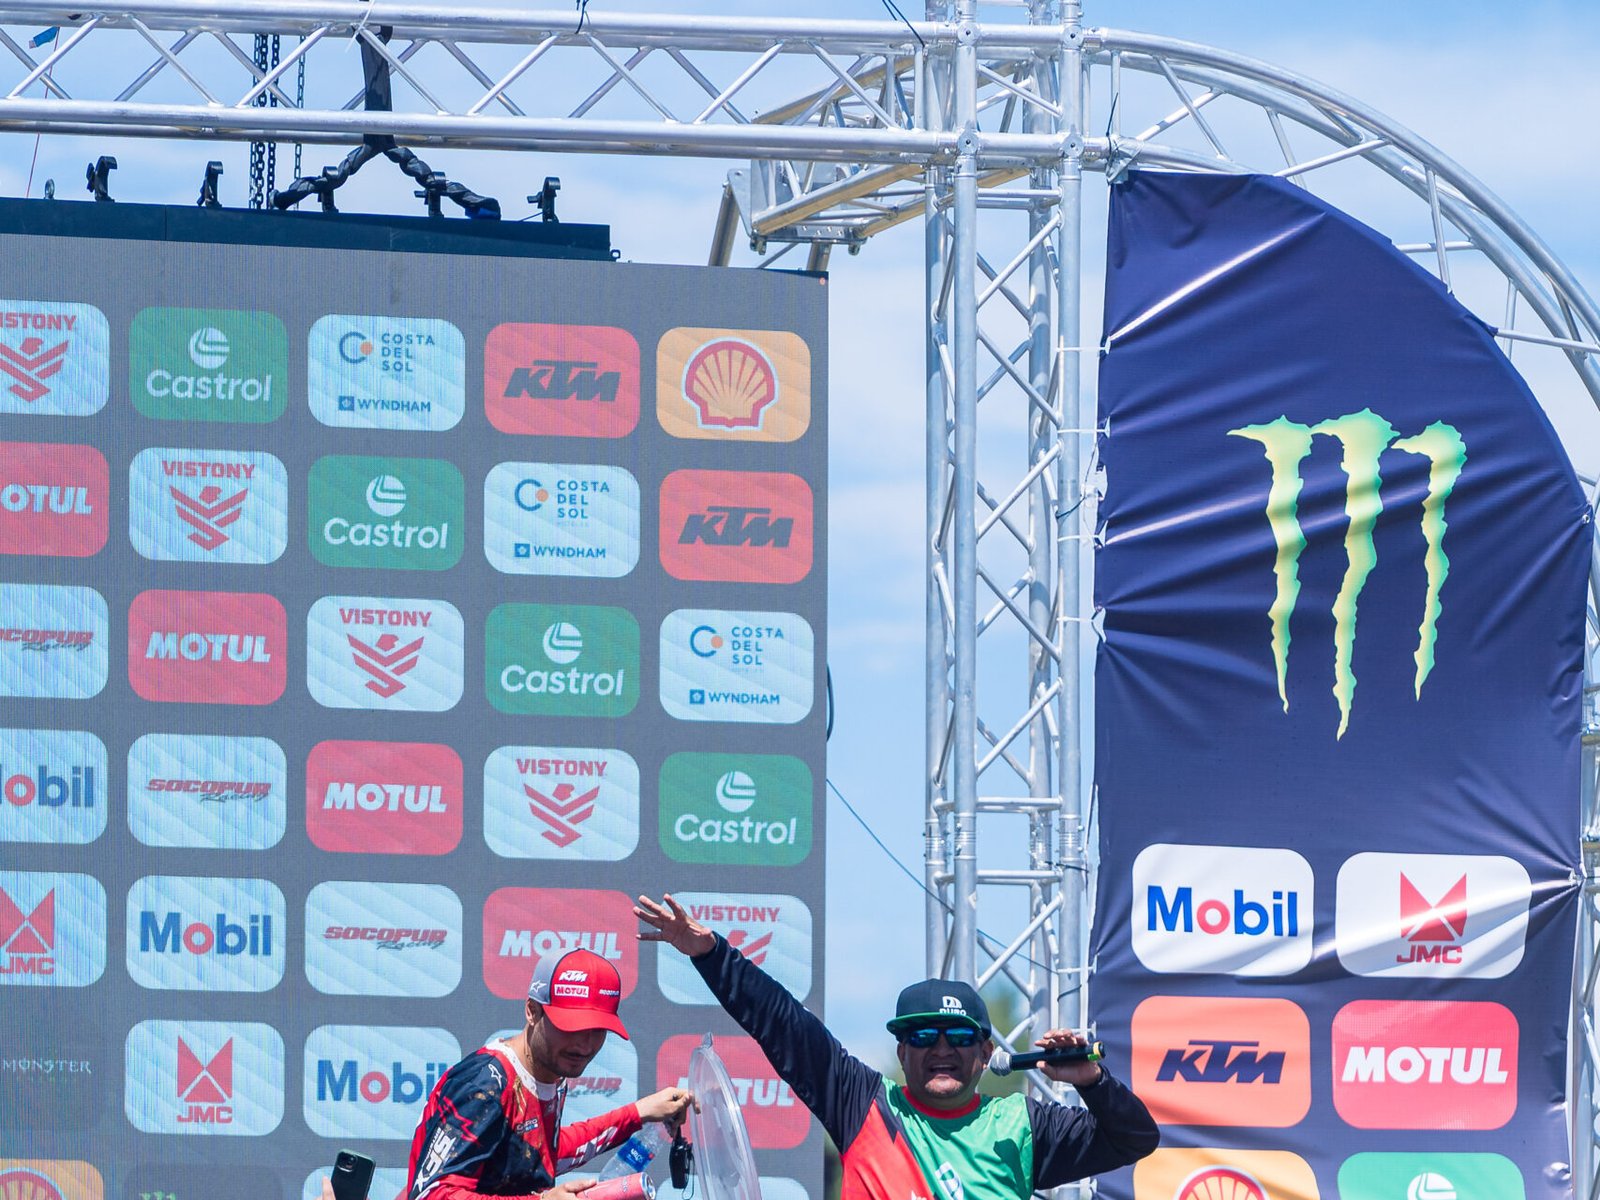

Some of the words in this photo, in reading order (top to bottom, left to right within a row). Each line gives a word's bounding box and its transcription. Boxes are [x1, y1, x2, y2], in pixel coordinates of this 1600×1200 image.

[0, 312, 77, 331] ISTONY
[381, 332, 436, 345] COSTA
[381, 346, 413, 359] DEL
[381, 360, 413, 372] SOL
[146, 369, 272, 401] Castrol
[503, 360, 622, 402] KTM
[357, 398, 431, 412] WYNDHAM
[162, 461, 256, 479] VISTONY
[557, 480, 610, 493] COSTA
[0, 484, 92, 515] OTUL
[557, 493, 589, 505] DEL
[557, 507, 589, 519] SOL
[323, 517, 449, 549] Castrol
[677, 505, 795, 548] KTM
[533, 545, 606, 558] WYNDHAM
[339, 608, 433, 627] VISTONY
[731, 626, 784, 639] COSTA
[145, 631, 271, 663] MOTUL
[732, 640, 764, 652] DEL
[732, 653, 763, 665] SOL
[501, 664, 624, 696] Castrol
[708, 691, 780, 705] WYNDHAM
[516, 758, 607, 777] VISTONY
[0, 765, 94, 808] obil
[146, 778, 272, 796] SOCOPUR
[322, 782, 448, 813] MOTUL
[674, 813, 796, 845] Castrol
[690, 905, 780, 922] VISTONY
[1147, 885, 1298, 937] Mobil
[139, 911, 271, 957] Mobil
[323, 926, 448, 943] SOCOPUR
[498, 929, 623, 959] MOTUL
[1396, 944, 1463, 964] JMC
[0, 956, 55, 975] JMC
[558, 970, 588, 982] KTM
[556, 986, 588, 997] MOTUL
[3, 1057, 92, 1074] MONSTER
[1155, 1039, 1286, 1084] KTM
[1342, 1046, 1509, 1084] MOTUL
[176, 1106, 233, 1124] JMC
